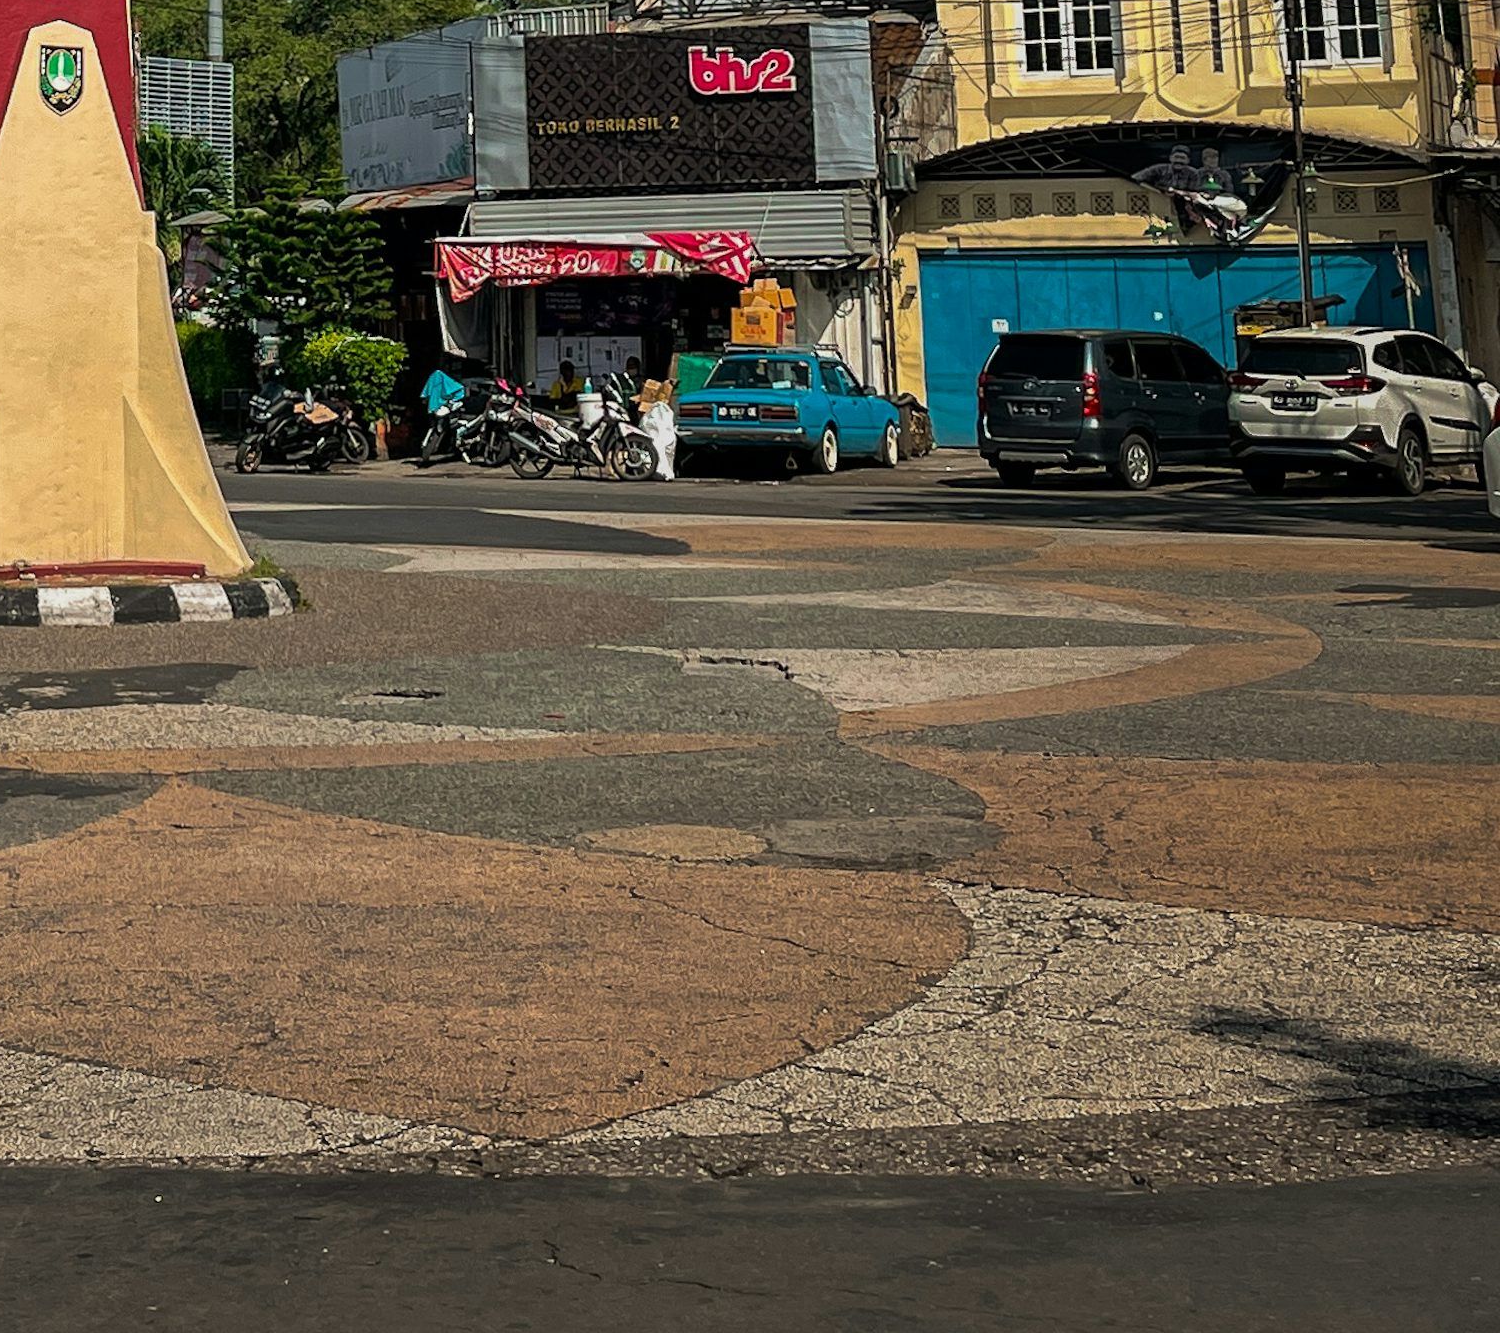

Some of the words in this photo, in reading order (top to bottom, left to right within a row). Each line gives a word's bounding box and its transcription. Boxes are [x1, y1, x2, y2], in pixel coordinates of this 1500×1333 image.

[536, 119, 580, 135] TOKO
[585, 116, 662, 133] BERHASIL
[669, 115, 680, 130] 2
